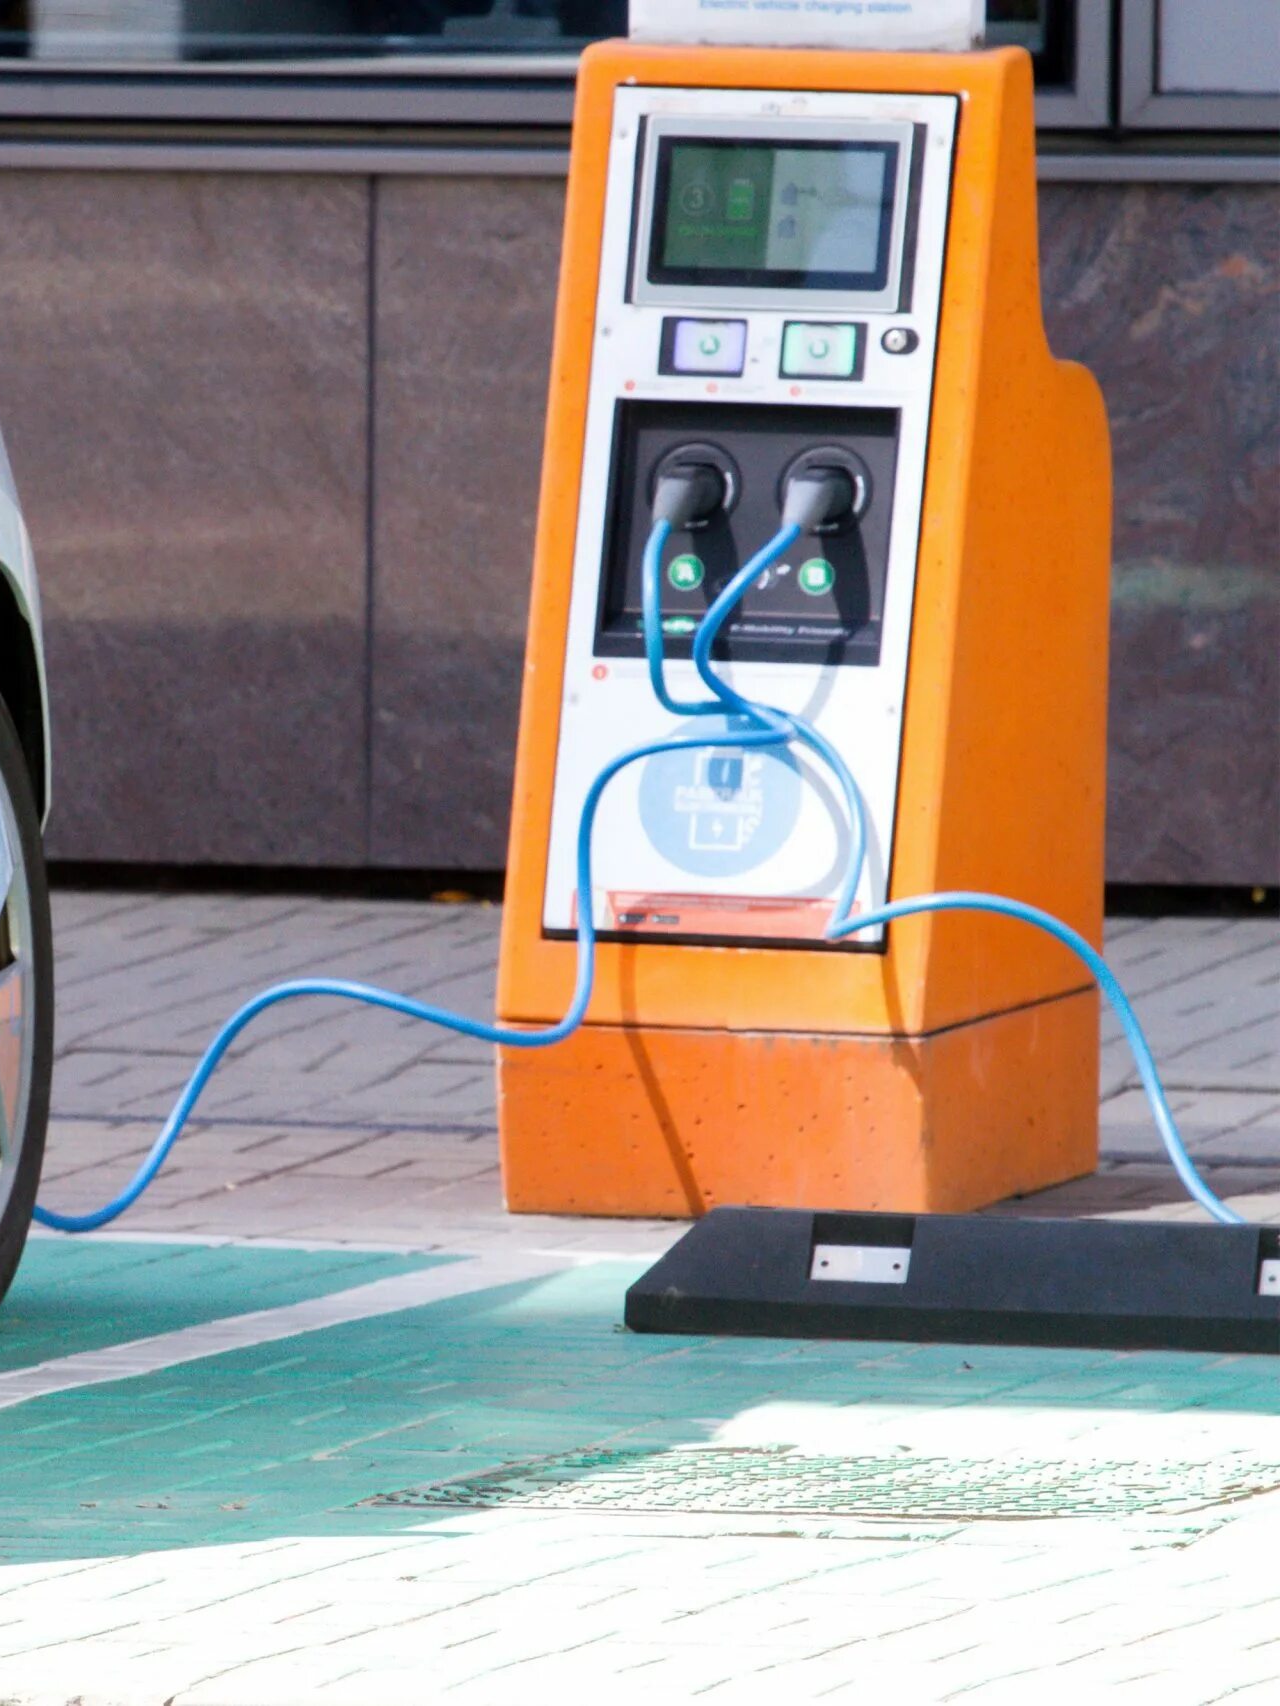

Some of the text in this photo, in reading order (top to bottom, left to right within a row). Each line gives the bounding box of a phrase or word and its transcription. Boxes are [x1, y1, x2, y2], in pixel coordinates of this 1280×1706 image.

[753, 1, 801, 12] vehicle
[805, 1, 863, 15] charging
[867, 3, 913, 14] station
